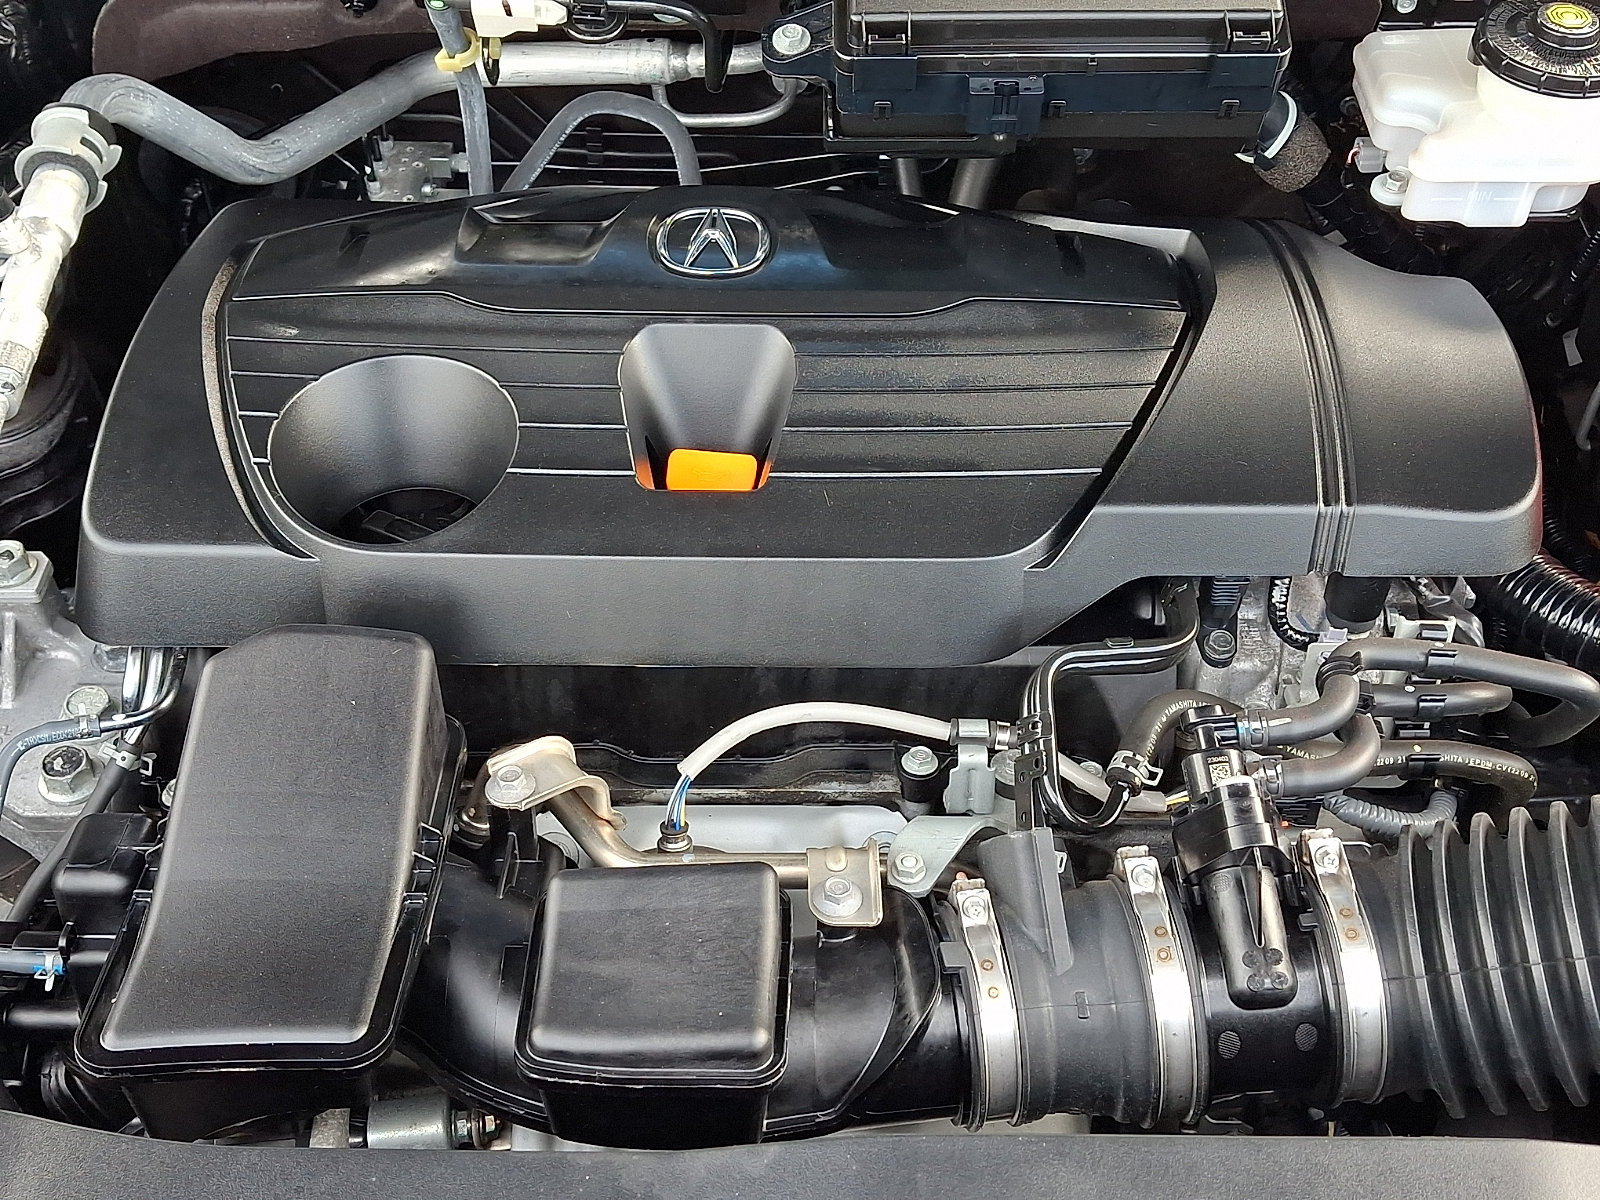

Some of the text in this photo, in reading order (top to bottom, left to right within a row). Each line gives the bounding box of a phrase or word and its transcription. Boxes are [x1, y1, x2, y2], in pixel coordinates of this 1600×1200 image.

[1466, 191, 1493, 201] MIN
[1165, 699, 1198, 717] YAMASHITA
[1285, 745, 1322, 760] YAMAS
[1374, 756, 1394, 767] 2209
